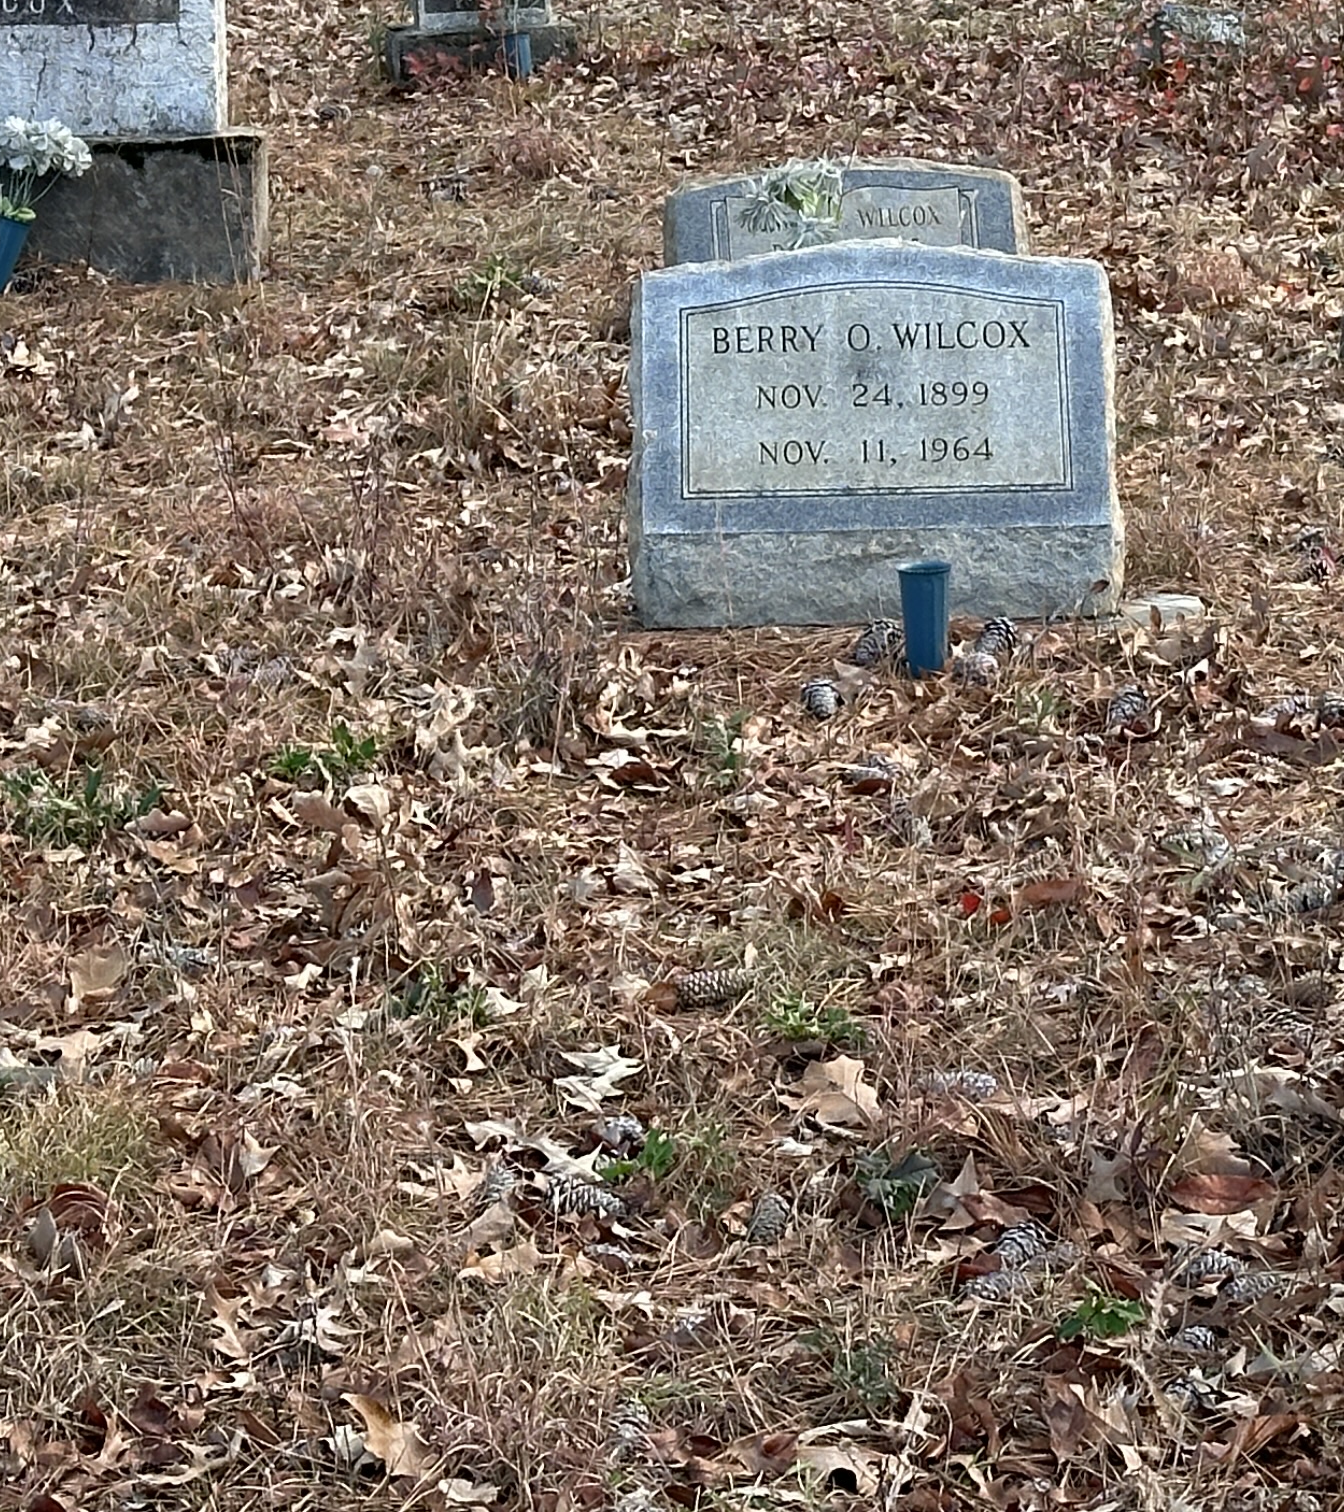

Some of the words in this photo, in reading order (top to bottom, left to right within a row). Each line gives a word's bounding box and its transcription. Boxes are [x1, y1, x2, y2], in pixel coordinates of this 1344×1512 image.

[856, 204, 943, 229] WILCOX
[713, 324, 825, 354] BERRY
[847, 322, 884, 352] O.
[892, 319, 1032, 350] WILCOX
[756, 384, 829, 410] NOV.
[852, 382, 905, 409] 24,
[918, 381, 990, 407] 1899
[758, 439, 829, 465] NOV.
[861, 438, 898, 467] 11,
[919, 436, 994, 463] 1964
